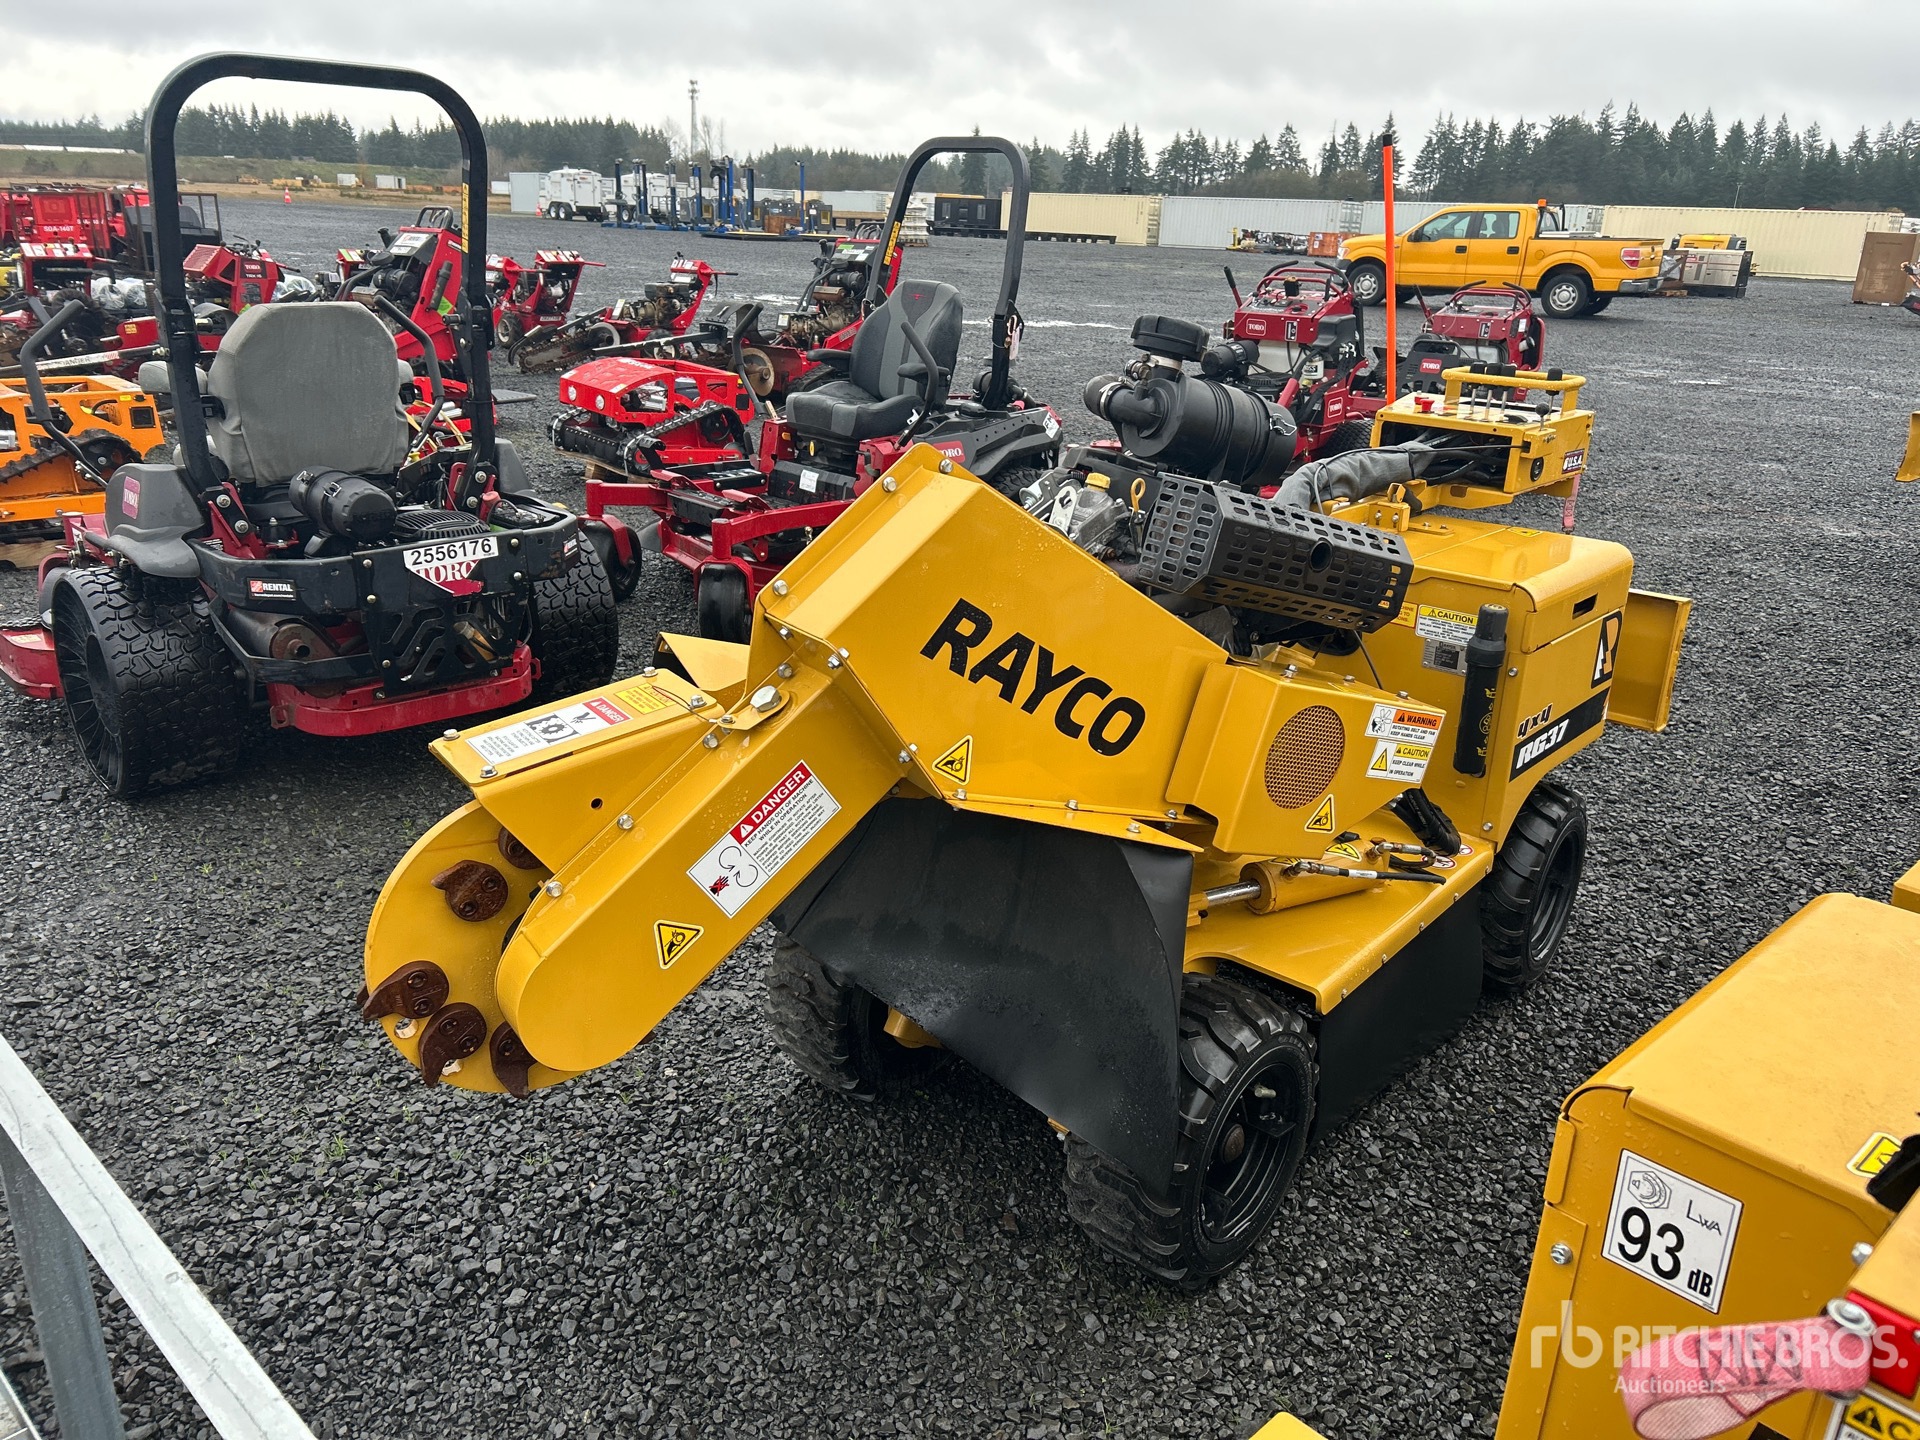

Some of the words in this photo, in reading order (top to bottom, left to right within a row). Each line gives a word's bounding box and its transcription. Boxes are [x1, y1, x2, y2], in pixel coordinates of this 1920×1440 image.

[1248, 323, 1265, 331] TORO
[1423, 362, 1440, 370] TORO
[411, 538, 492, 566] 2556176
[262, 583, 293, 592] RENTAL
[1437, 610, 1474, 623] CAUTION
[920, 598, 1146, 756] RAYCO
[594, 703, 625, 722] DANGER
[1406, 715, 1437, 726] WARNING
[1402, 747, 1429, 757] CAUTION
[1516, 718, 1570, 769] RG37
[744, 833, 758, 847] KEEP
[757, 816, 775, 834] HANDS
[774, 806, 785, 818] OUT
[784, 799, 792, 807] OF
[791, 778, 813, 801] MACHINE
[750, 769, 805, 824] DANGER
[753, 841, 768, 856] MACHINE
[792, 803, 805, 817] ROTATE
[805, 792, 817, 804] AFTER
[758, 824, 774, 841] WHILE
[779, 792, 807, 820] OPERATION
[778, 834, 787, 843] THAT
[794, 810, 811, 827] ROTATION
[755, 846, 768, 859] POWER
[794, 811, 804, 821] LOOK
[1617, 1206, 1685, 1281] 93
[1687, 1268, 1714, 1298] dB
